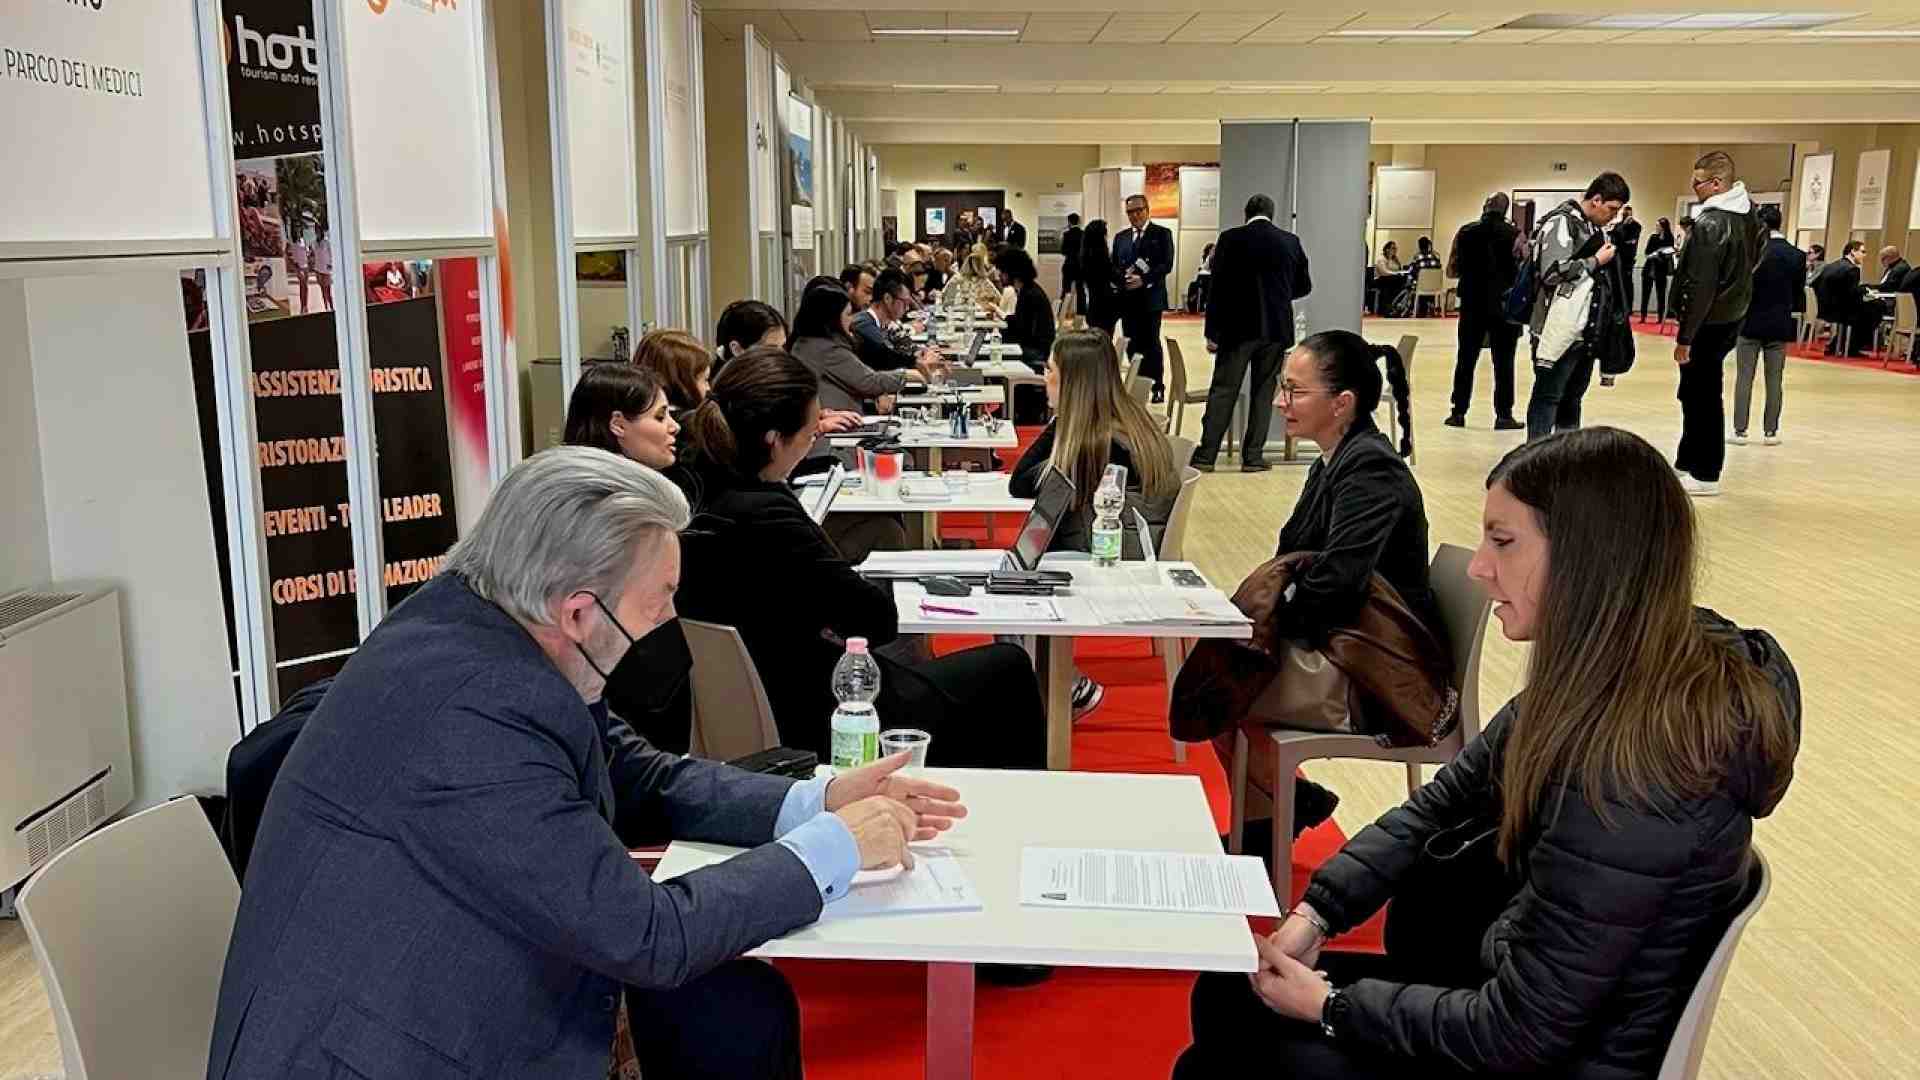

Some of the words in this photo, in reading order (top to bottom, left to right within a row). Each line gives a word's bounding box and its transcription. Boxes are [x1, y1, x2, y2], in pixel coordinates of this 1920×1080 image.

[235, 14, 320, 74] hot
[5, 48, 59, 84] PARCO
[60, 59, 88, 89] DEI
[91, 64, 142, 97] MEDICI
[241, 66, 278, 81] tourism
[281, 72, 299, 84] and
[233, 123, 321, 146] w.hotsp
[251, 368, 342, 397] ASSISTENZ
[369, 366, 433, 393] RISTICA
[258, 436, 347, 467] RISTORAZI
[264, 504, 327, 537] EVENTI
[383, 493, 443, 522] LEADER
[272, 572, 325, 605] CORSI
[327, 570, 346, 597] DI
